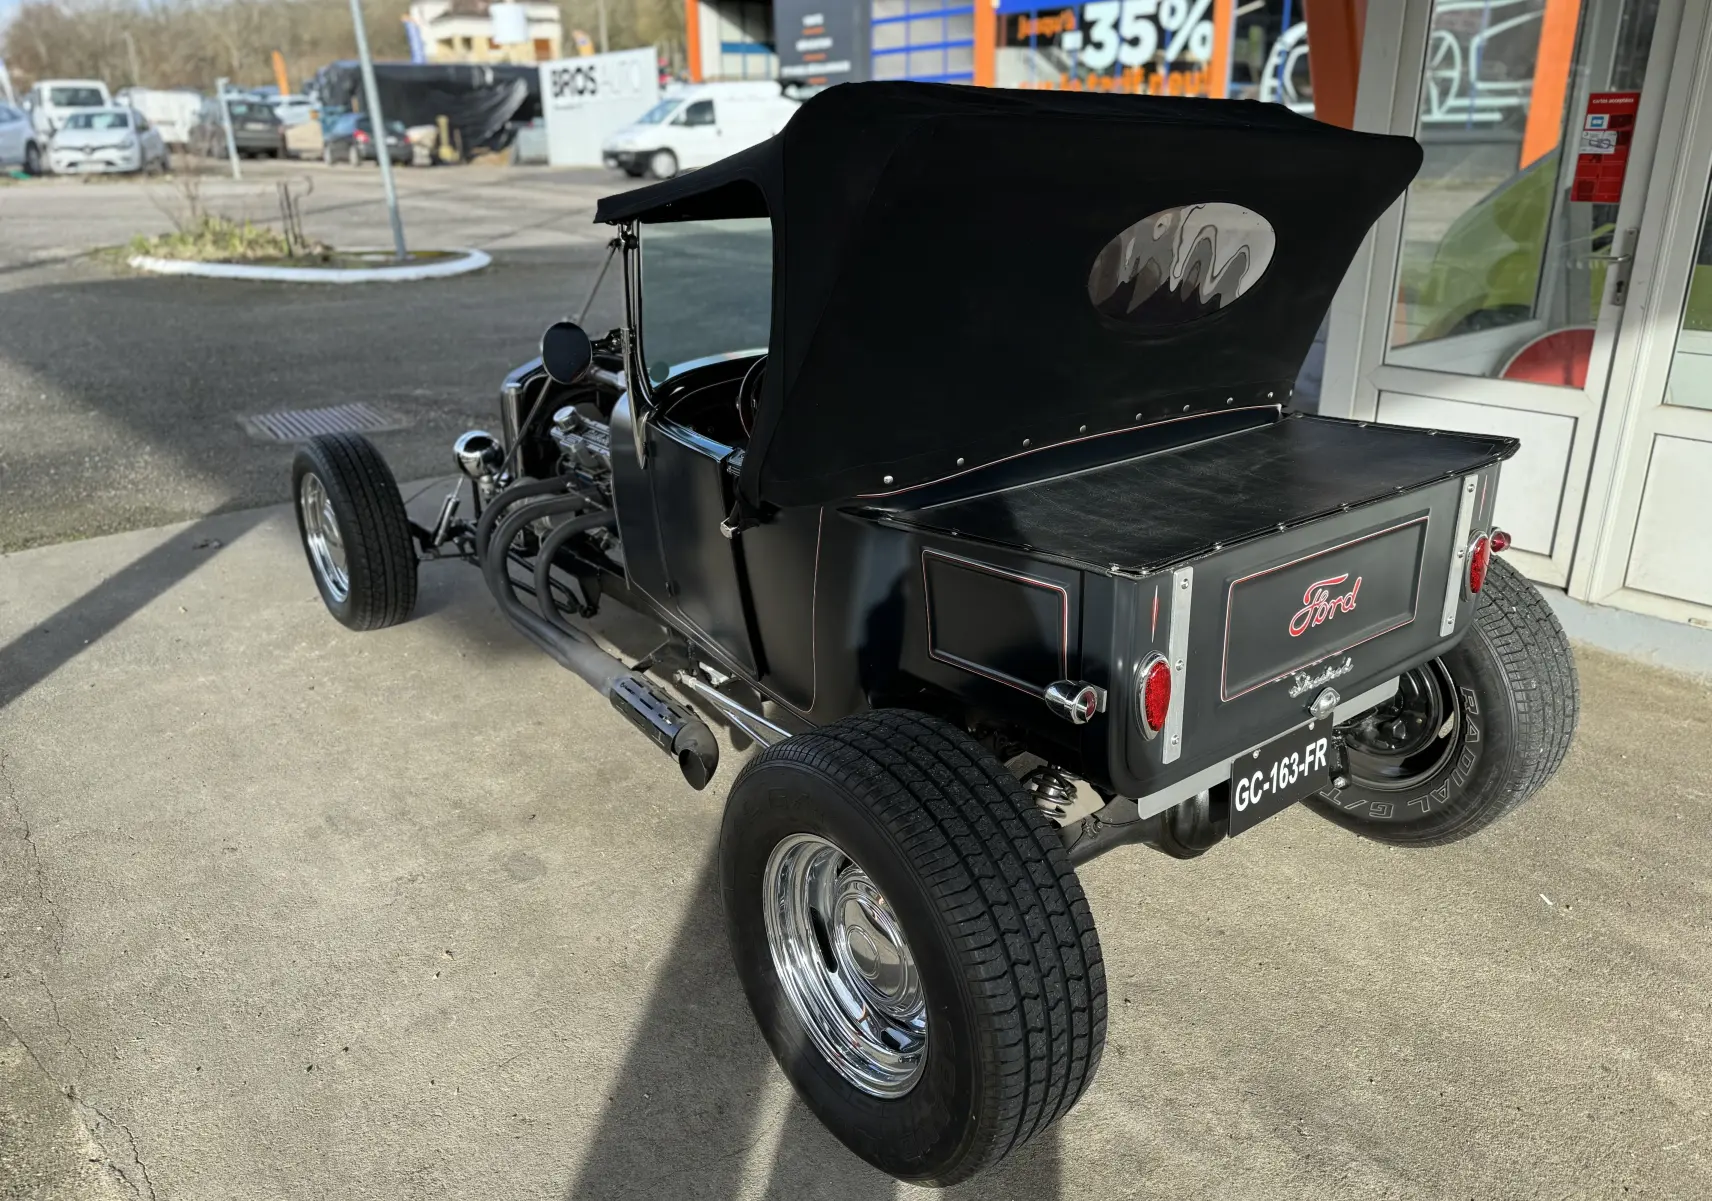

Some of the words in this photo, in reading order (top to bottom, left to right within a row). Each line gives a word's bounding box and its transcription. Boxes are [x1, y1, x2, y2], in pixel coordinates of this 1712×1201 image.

[1061, 0, 1214, 69] -35%
[551, 65, 598, 98] BROS
[1288, 573, 1362, 637] Ford
[1235, 737, 1328, 812] GC-163-FR
[1406, 686, 1481, 813] RADIAL
[1319, 787, 1394, 819] G/T
